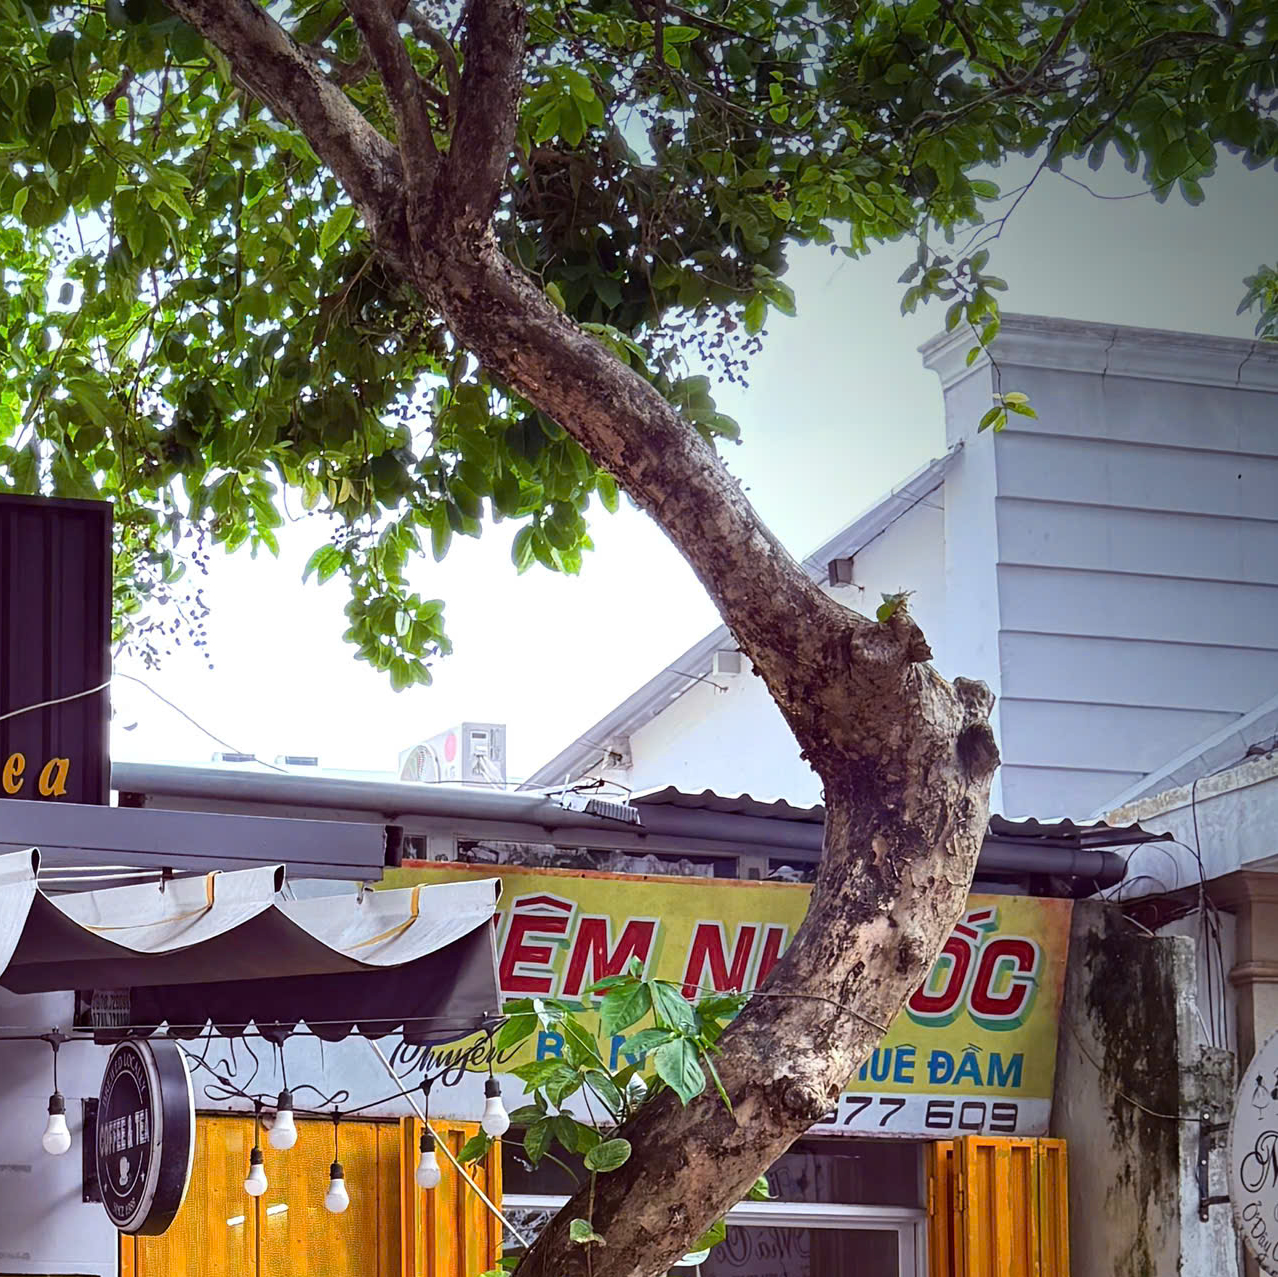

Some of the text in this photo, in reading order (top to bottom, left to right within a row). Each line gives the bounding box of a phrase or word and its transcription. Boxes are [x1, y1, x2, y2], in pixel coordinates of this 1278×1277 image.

[927, 1042, 1024, 1088] ĐẦM
[134, 1108, 151, 1146] TEA
[924, 1100, 1019, 1133] 609
